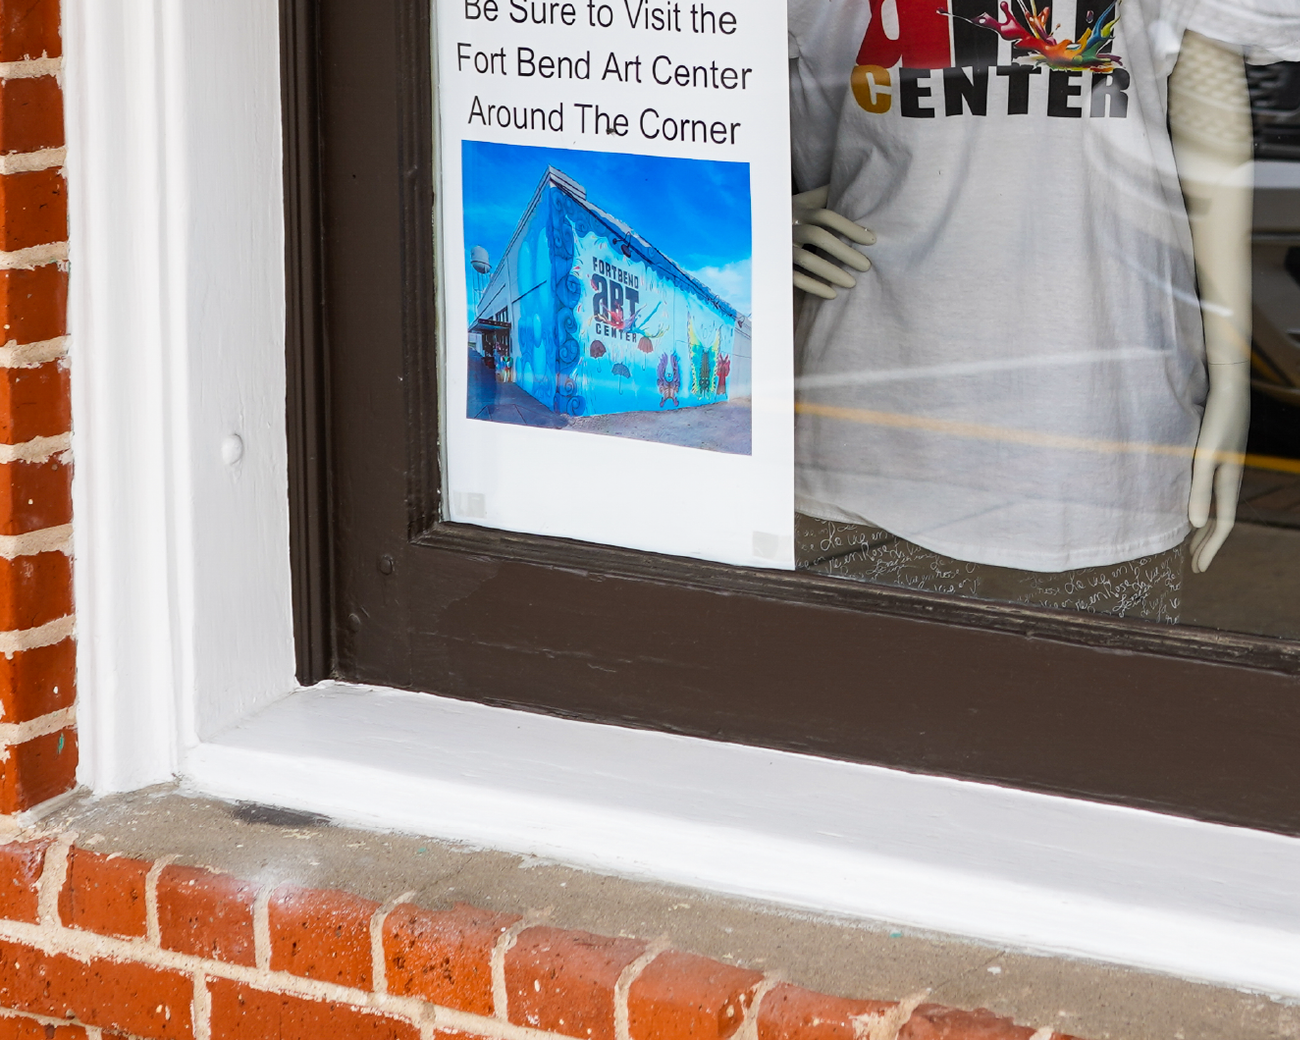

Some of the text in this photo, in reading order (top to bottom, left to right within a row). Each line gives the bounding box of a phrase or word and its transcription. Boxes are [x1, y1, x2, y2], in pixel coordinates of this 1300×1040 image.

[690, 3, 737, 35] the
[457, 43, 753, 90] Fort Bend Art Center
[851, 64, 1131, 119] CENTER
[467, 95, 741, 145] Around The Corner
[595, 322, 638, 344] CENTER
